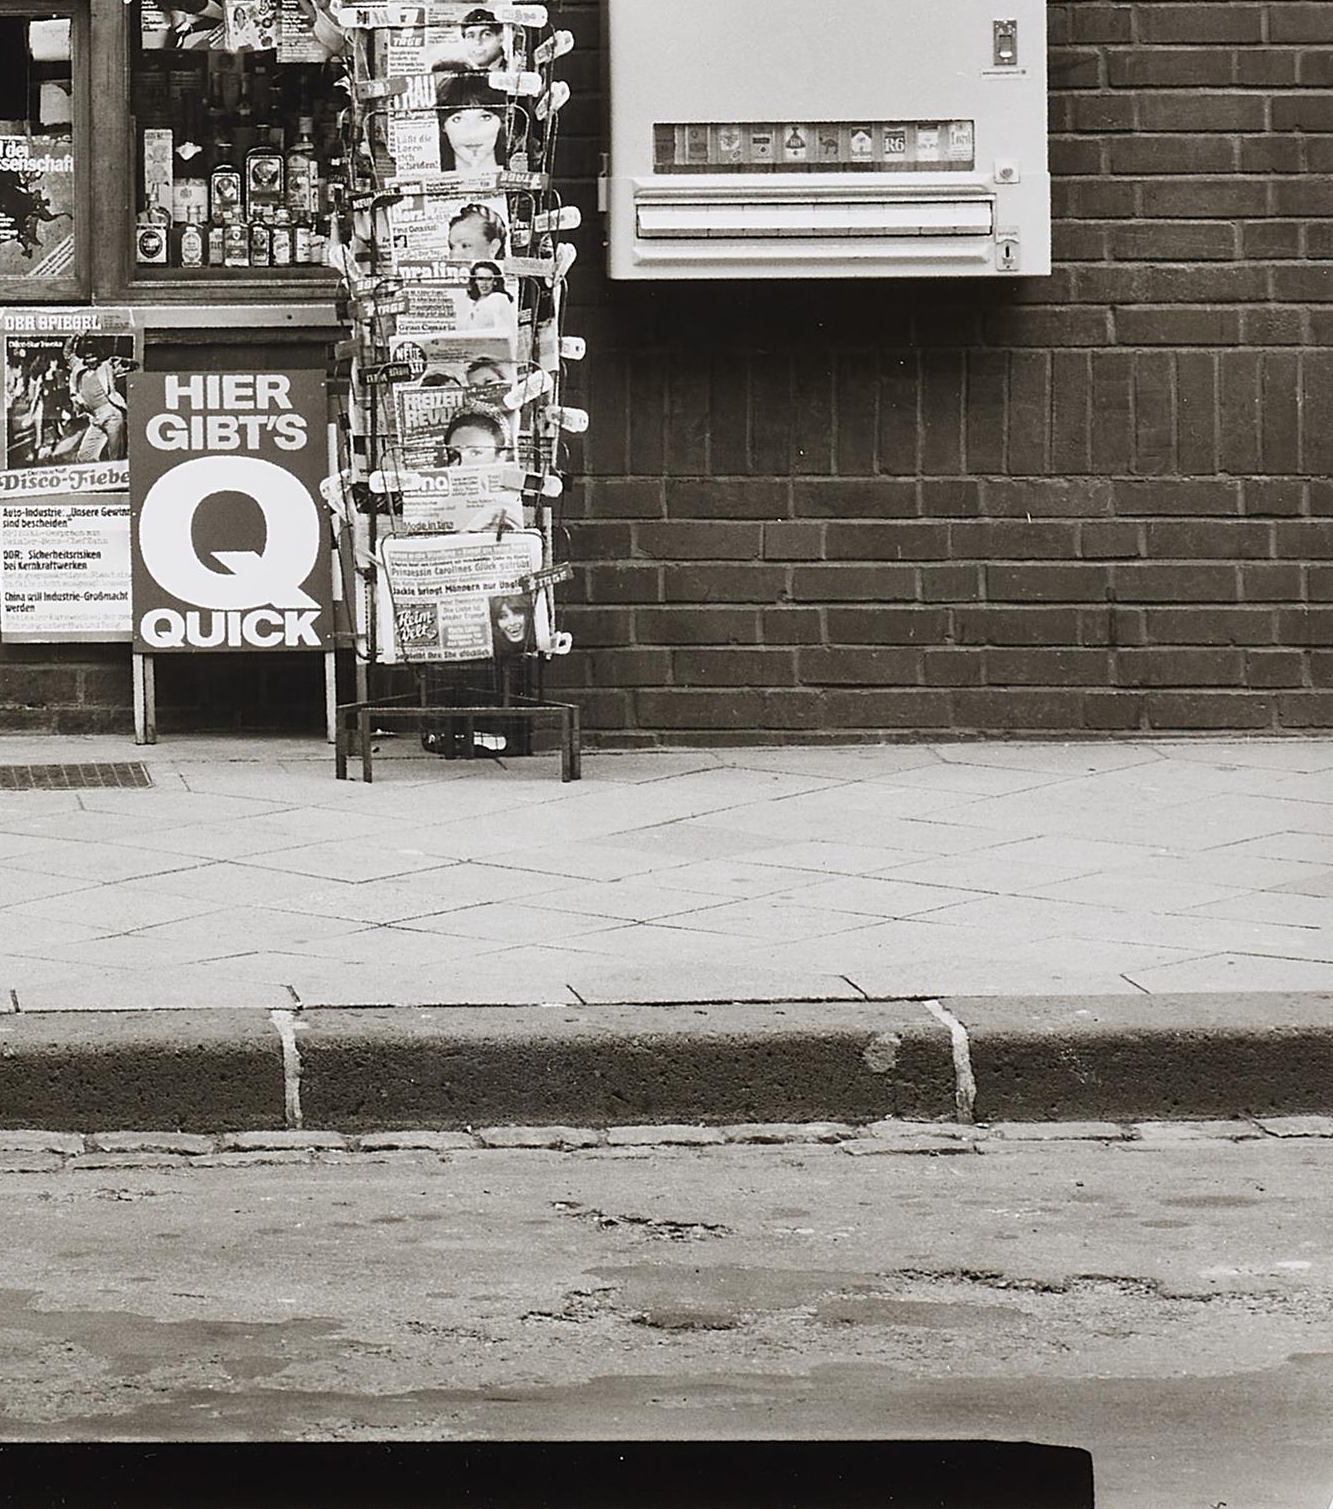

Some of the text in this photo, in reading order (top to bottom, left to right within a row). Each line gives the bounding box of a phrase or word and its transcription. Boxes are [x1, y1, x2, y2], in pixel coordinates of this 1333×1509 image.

[885, 137, 905, 154] R6
[4, 314, 102, 331] DER SPIEGEL
[165, 375, 293, 409] HIER
[146, 414, 308, 450] GIBT'S
[3, 518, 20, 528] sind
[139, 455, 322, 610] Q
[28, 550, 101, 559] Sicherheitsrisiken
[4, 561, 87, 570] bei Kernkraftwerken
[5, 592, 25, 601] China
[27, 591, 41, 601] will
[6, 604, 35, 612] werden
[140, 608, 322, 647] QUICK
